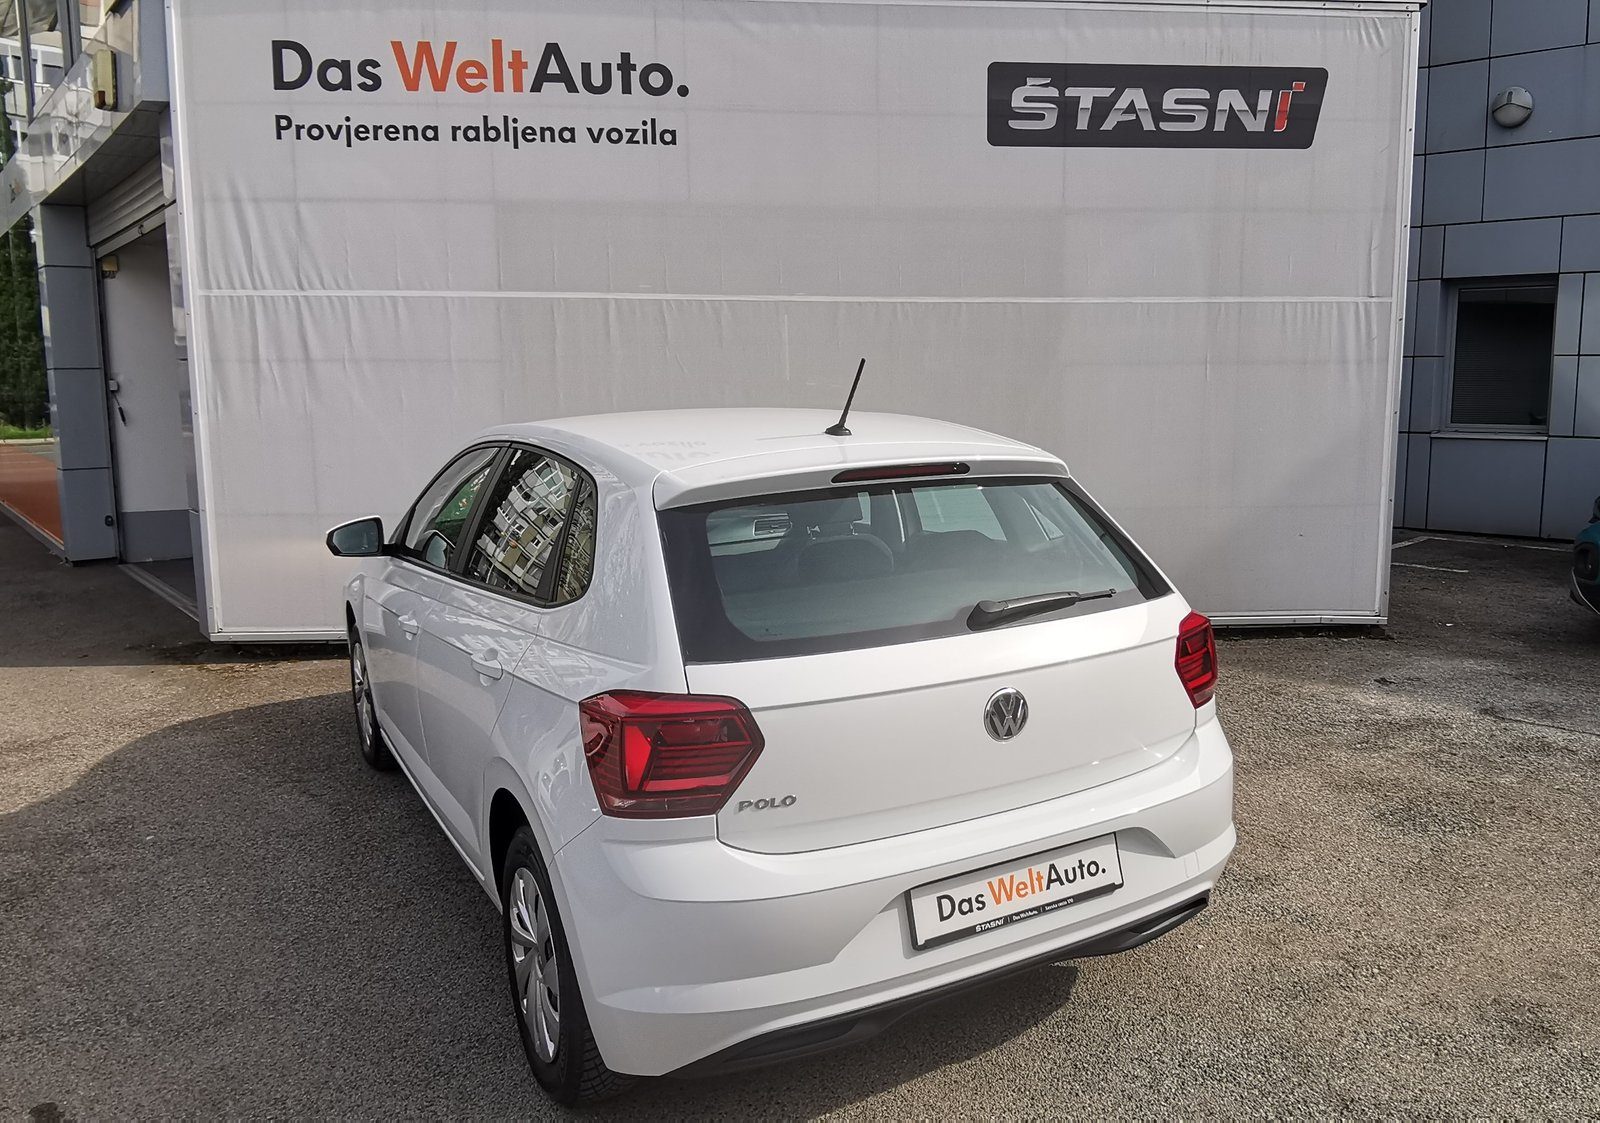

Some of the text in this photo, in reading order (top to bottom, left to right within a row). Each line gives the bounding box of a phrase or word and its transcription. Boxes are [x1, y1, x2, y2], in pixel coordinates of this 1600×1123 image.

[272, 39, 690, 97] Das WeltAuto.
[275, 115, 677, 149] Provjerena rabljena vozila
[738, 795, 797, 813] POLO
[936, 858, 1106, 922] Das WeltAuto.
